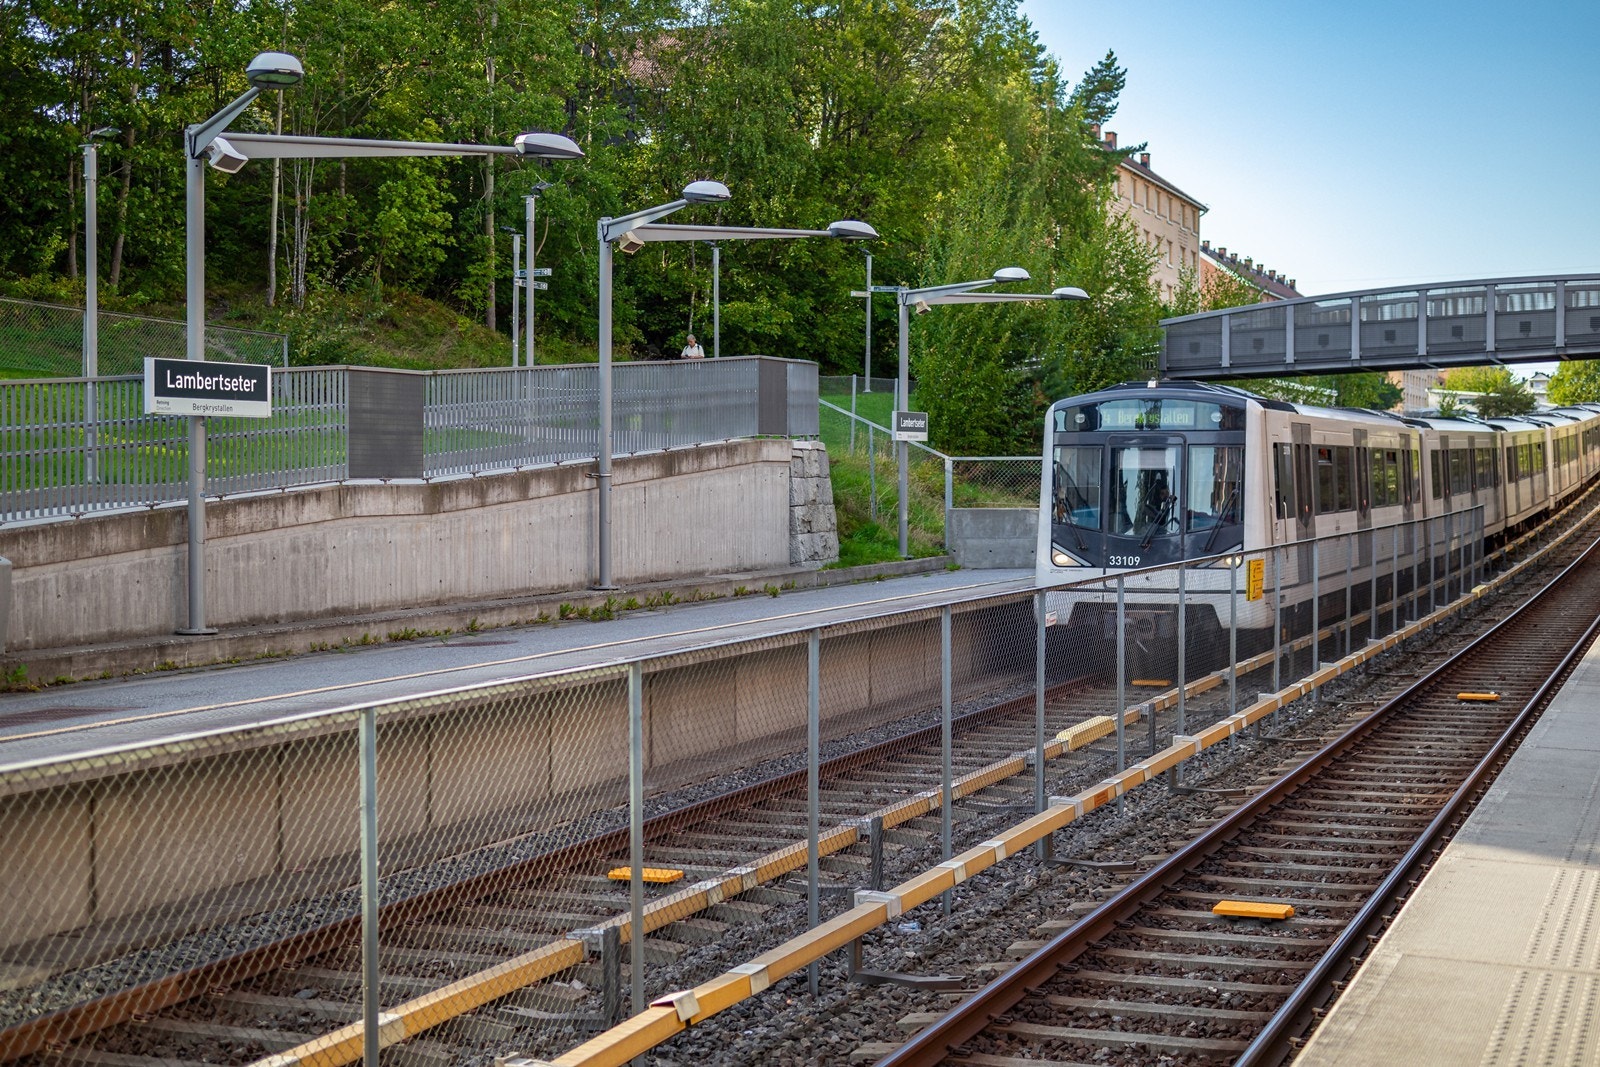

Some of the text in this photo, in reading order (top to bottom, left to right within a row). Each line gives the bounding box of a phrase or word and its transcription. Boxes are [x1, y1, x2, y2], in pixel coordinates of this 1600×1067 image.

[166, 369, 257, 392] Lambertseter
[192, 402, 233, 413] Bergkrystallen
[1109, 555, 1141, 566] 33109
